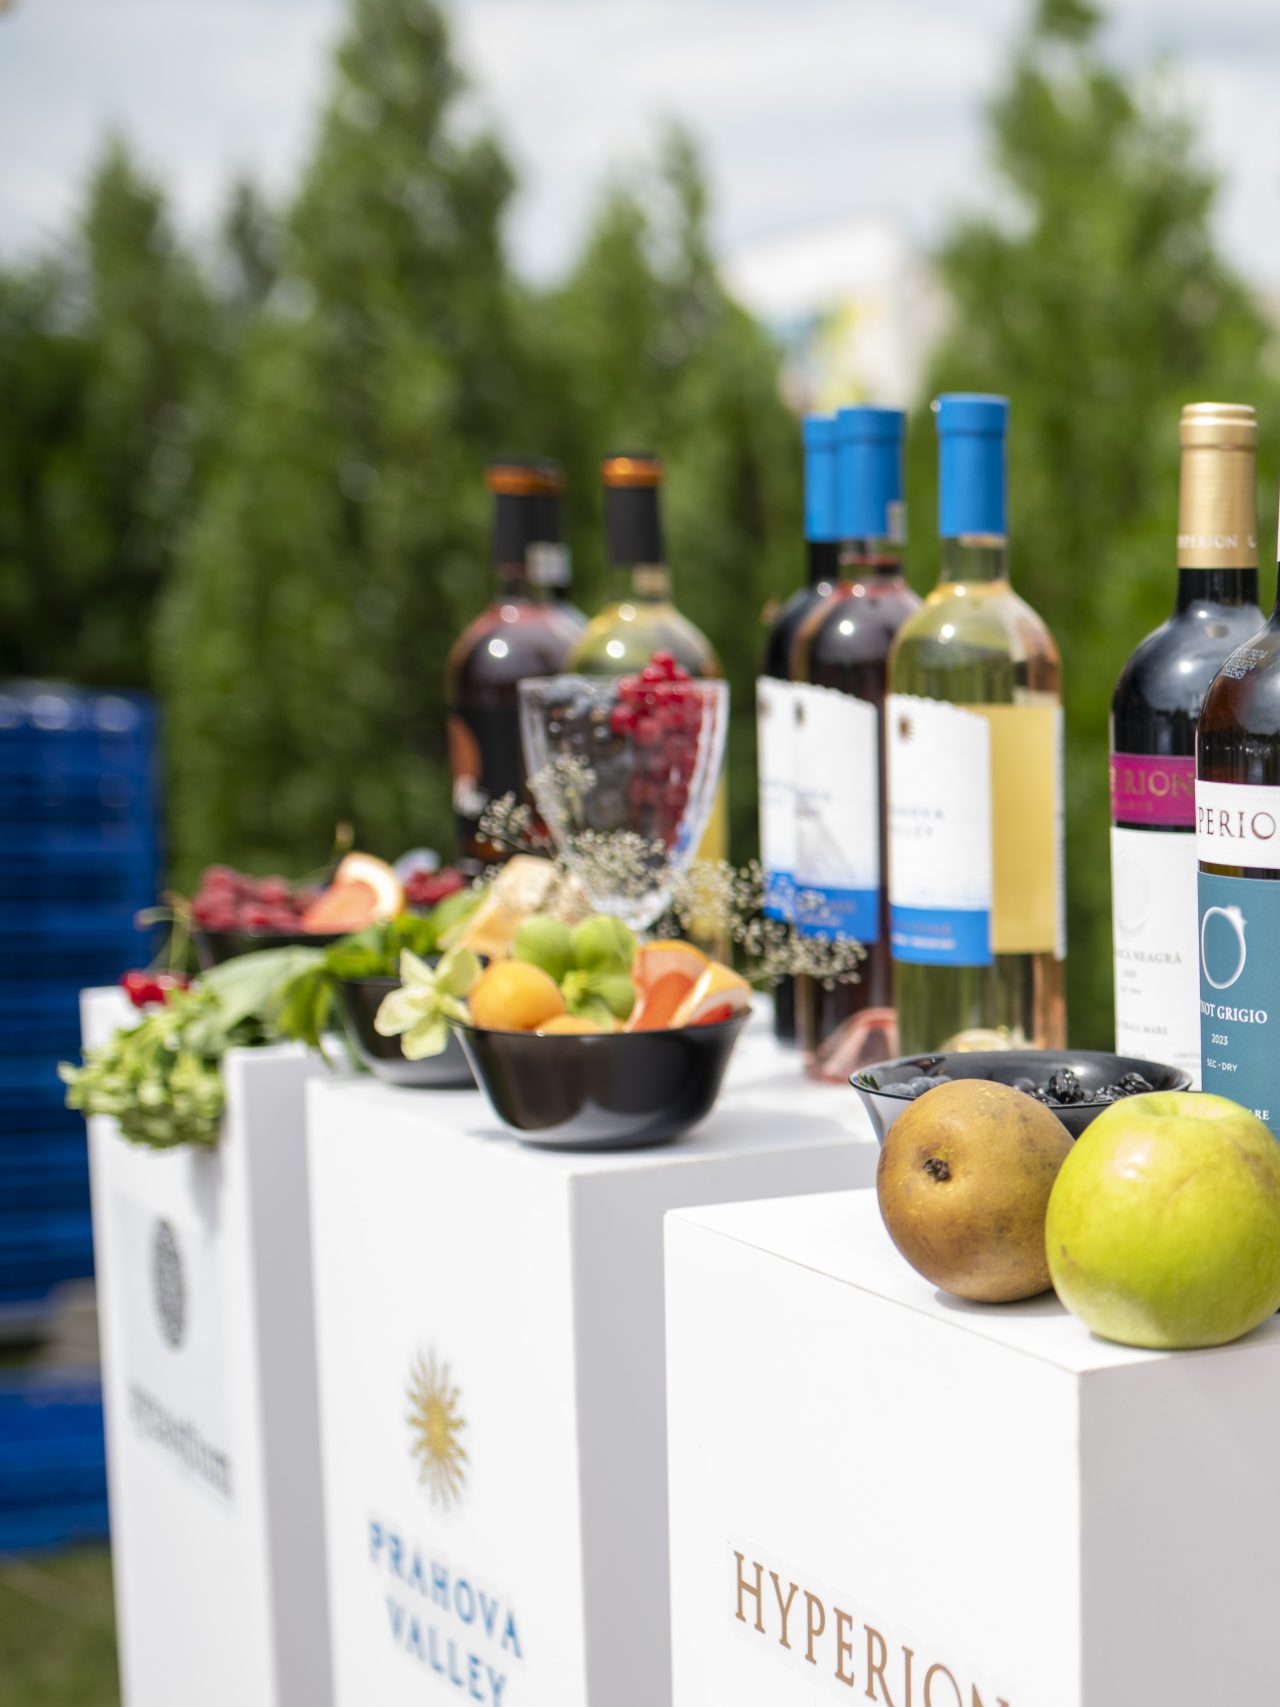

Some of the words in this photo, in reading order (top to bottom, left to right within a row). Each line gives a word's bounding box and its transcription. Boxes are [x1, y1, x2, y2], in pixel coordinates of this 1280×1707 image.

[1211, 1033, 1229, 1046] 2023
[1217, 1005, 1268, 1024] GRIGIO
[368, 1520, 523, 1659] PRAHOVA
[385, 1596, 507, 1707] VALLEY
